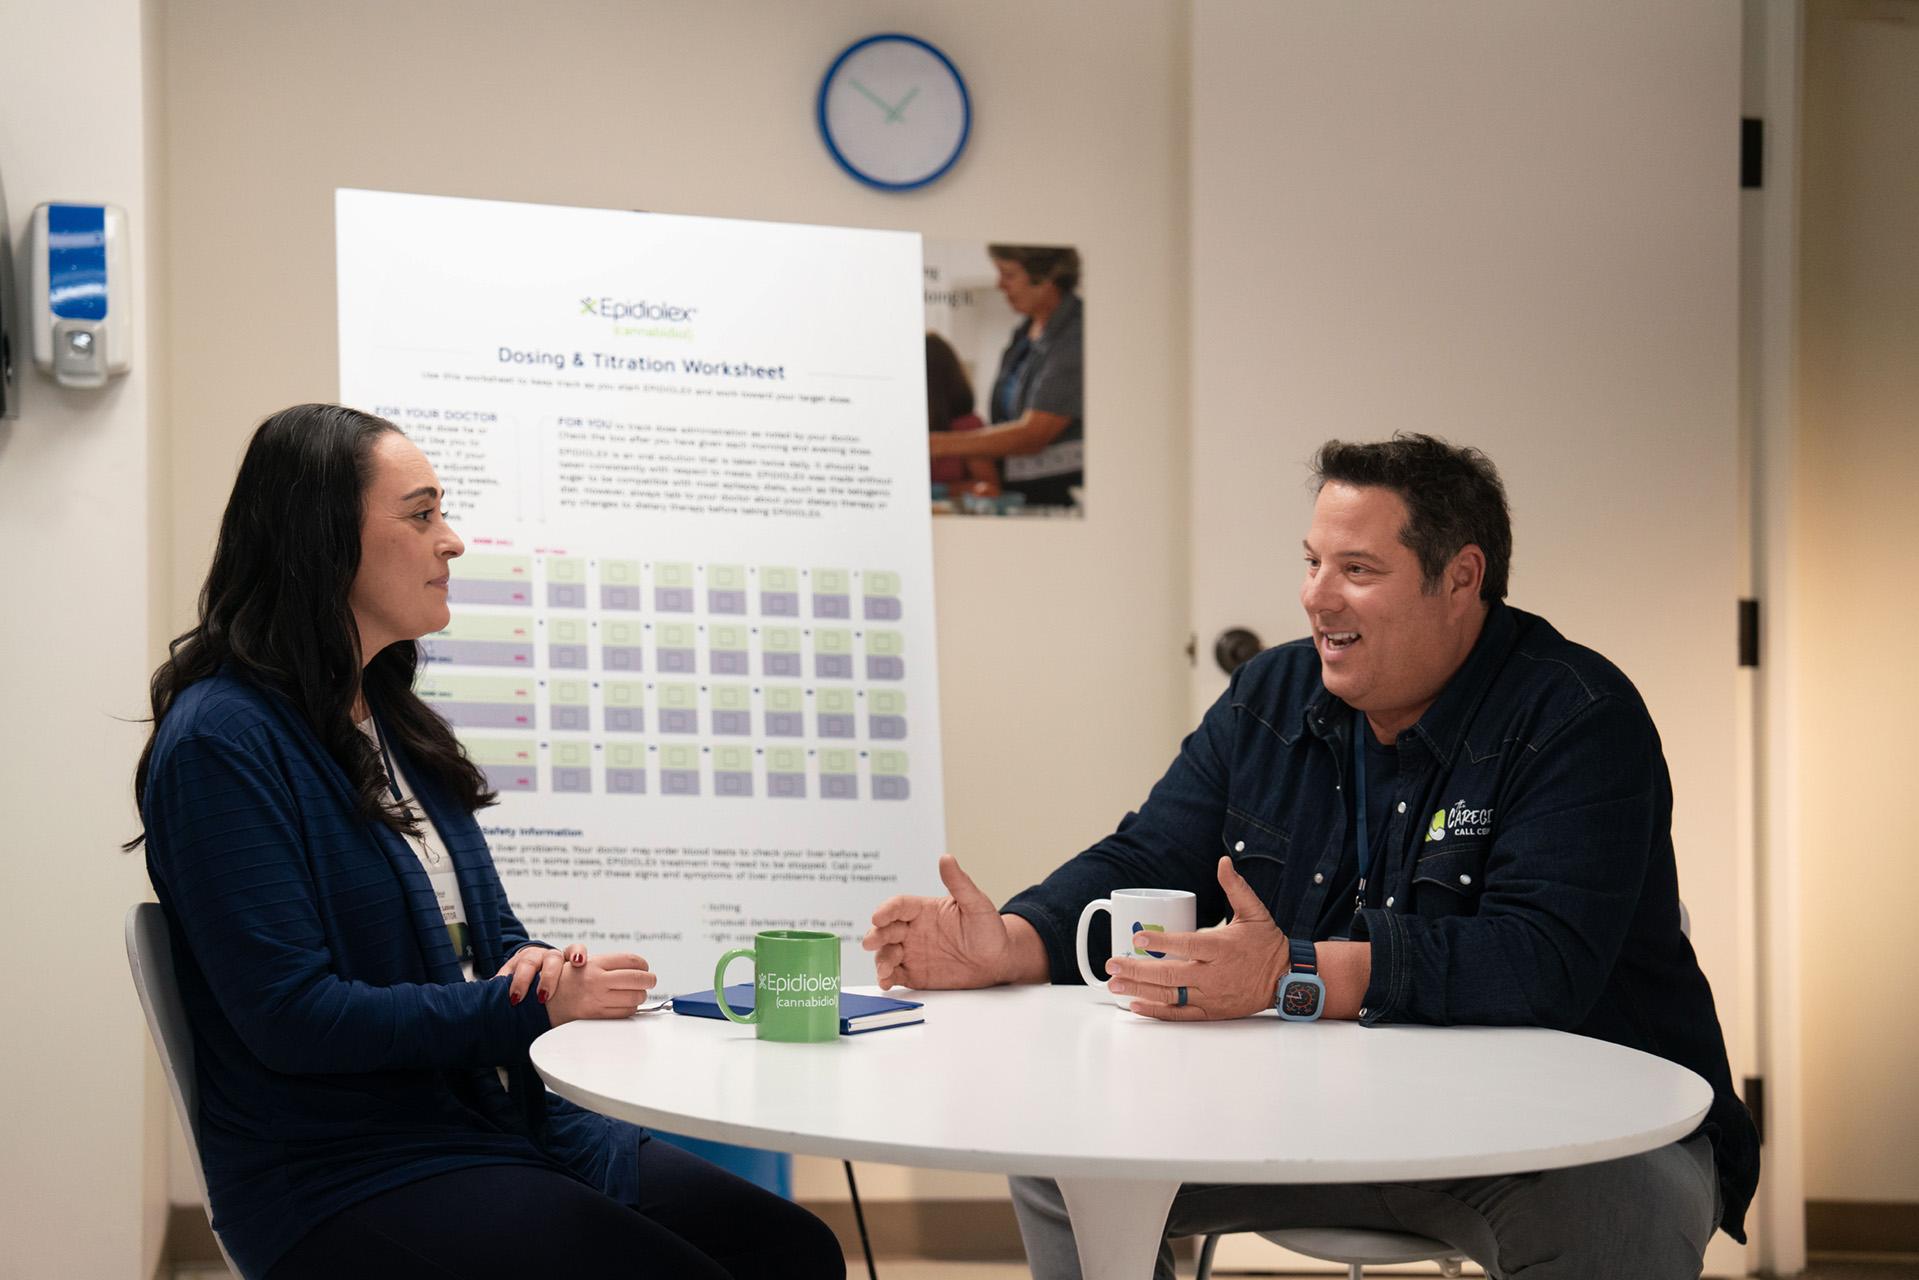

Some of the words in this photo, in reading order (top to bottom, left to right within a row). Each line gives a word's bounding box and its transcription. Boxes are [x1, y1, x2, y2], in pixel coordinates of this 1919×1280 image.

[600, 299, 692, 321] Epidiolex
[498, 346, 565, 369] Dosing
[573, 353, 584, 367] &
[592, 352, 676, 373] Titration
[681, 359, 786, 380] Worksheet
[375, 406, 401, 417] FOR
[406, 408, 440, 419] YOUR
[443, 410, 498, 422] DOCTOR
[558, 415, 584, 426] FOR
[587, 417, 612, 428] YOU
[520, 827, 582, 838] Information
[1454, 828, 1475, 836] CALL
